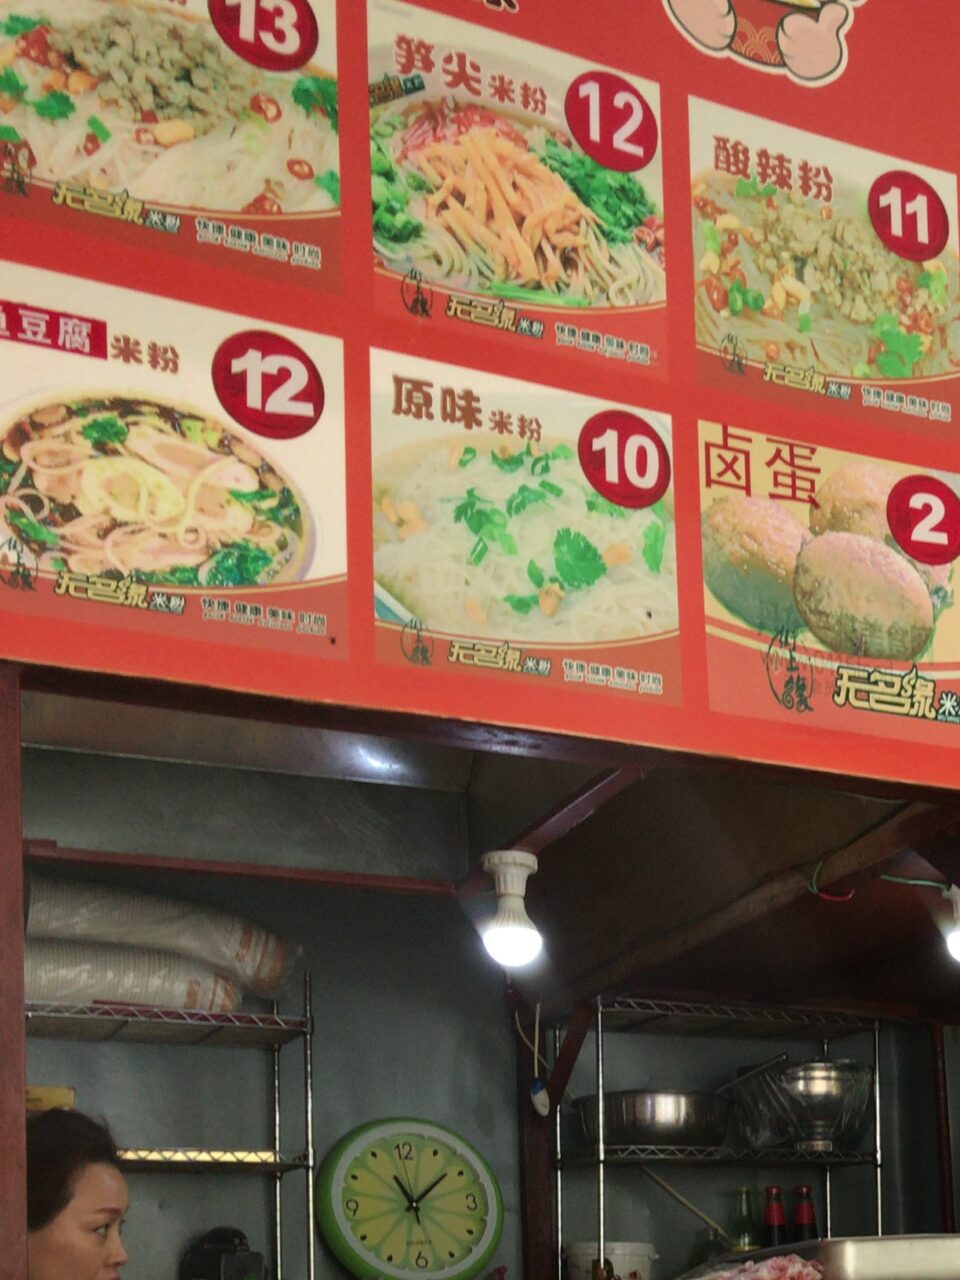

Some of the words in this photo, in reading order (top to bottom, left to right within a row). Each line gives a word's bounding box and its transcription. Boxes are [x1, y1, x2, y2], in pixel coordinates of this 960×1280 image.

[227, 0, 301, 54] 13
[577, 81, 644, 158] 12
[713, 134, 834, 203] 酸辣粉
[879, 186, 929, 245] 11
[111, 334, 180, 374] 米粉
[231, 348, 315, 419] 12
[392, 373, 543, 441] 原味米粉
[591, 431, 661, 490] 10
[704, 424, 821, 510] 卤蛋
[908, 492, 949, 546] 2
[394, 1142, 414, 1161] 12
[346, 1199, 359, 1217] 9
[465, 1193, 477, 1212] 3
[415, 1251, 428, 1269] 6
